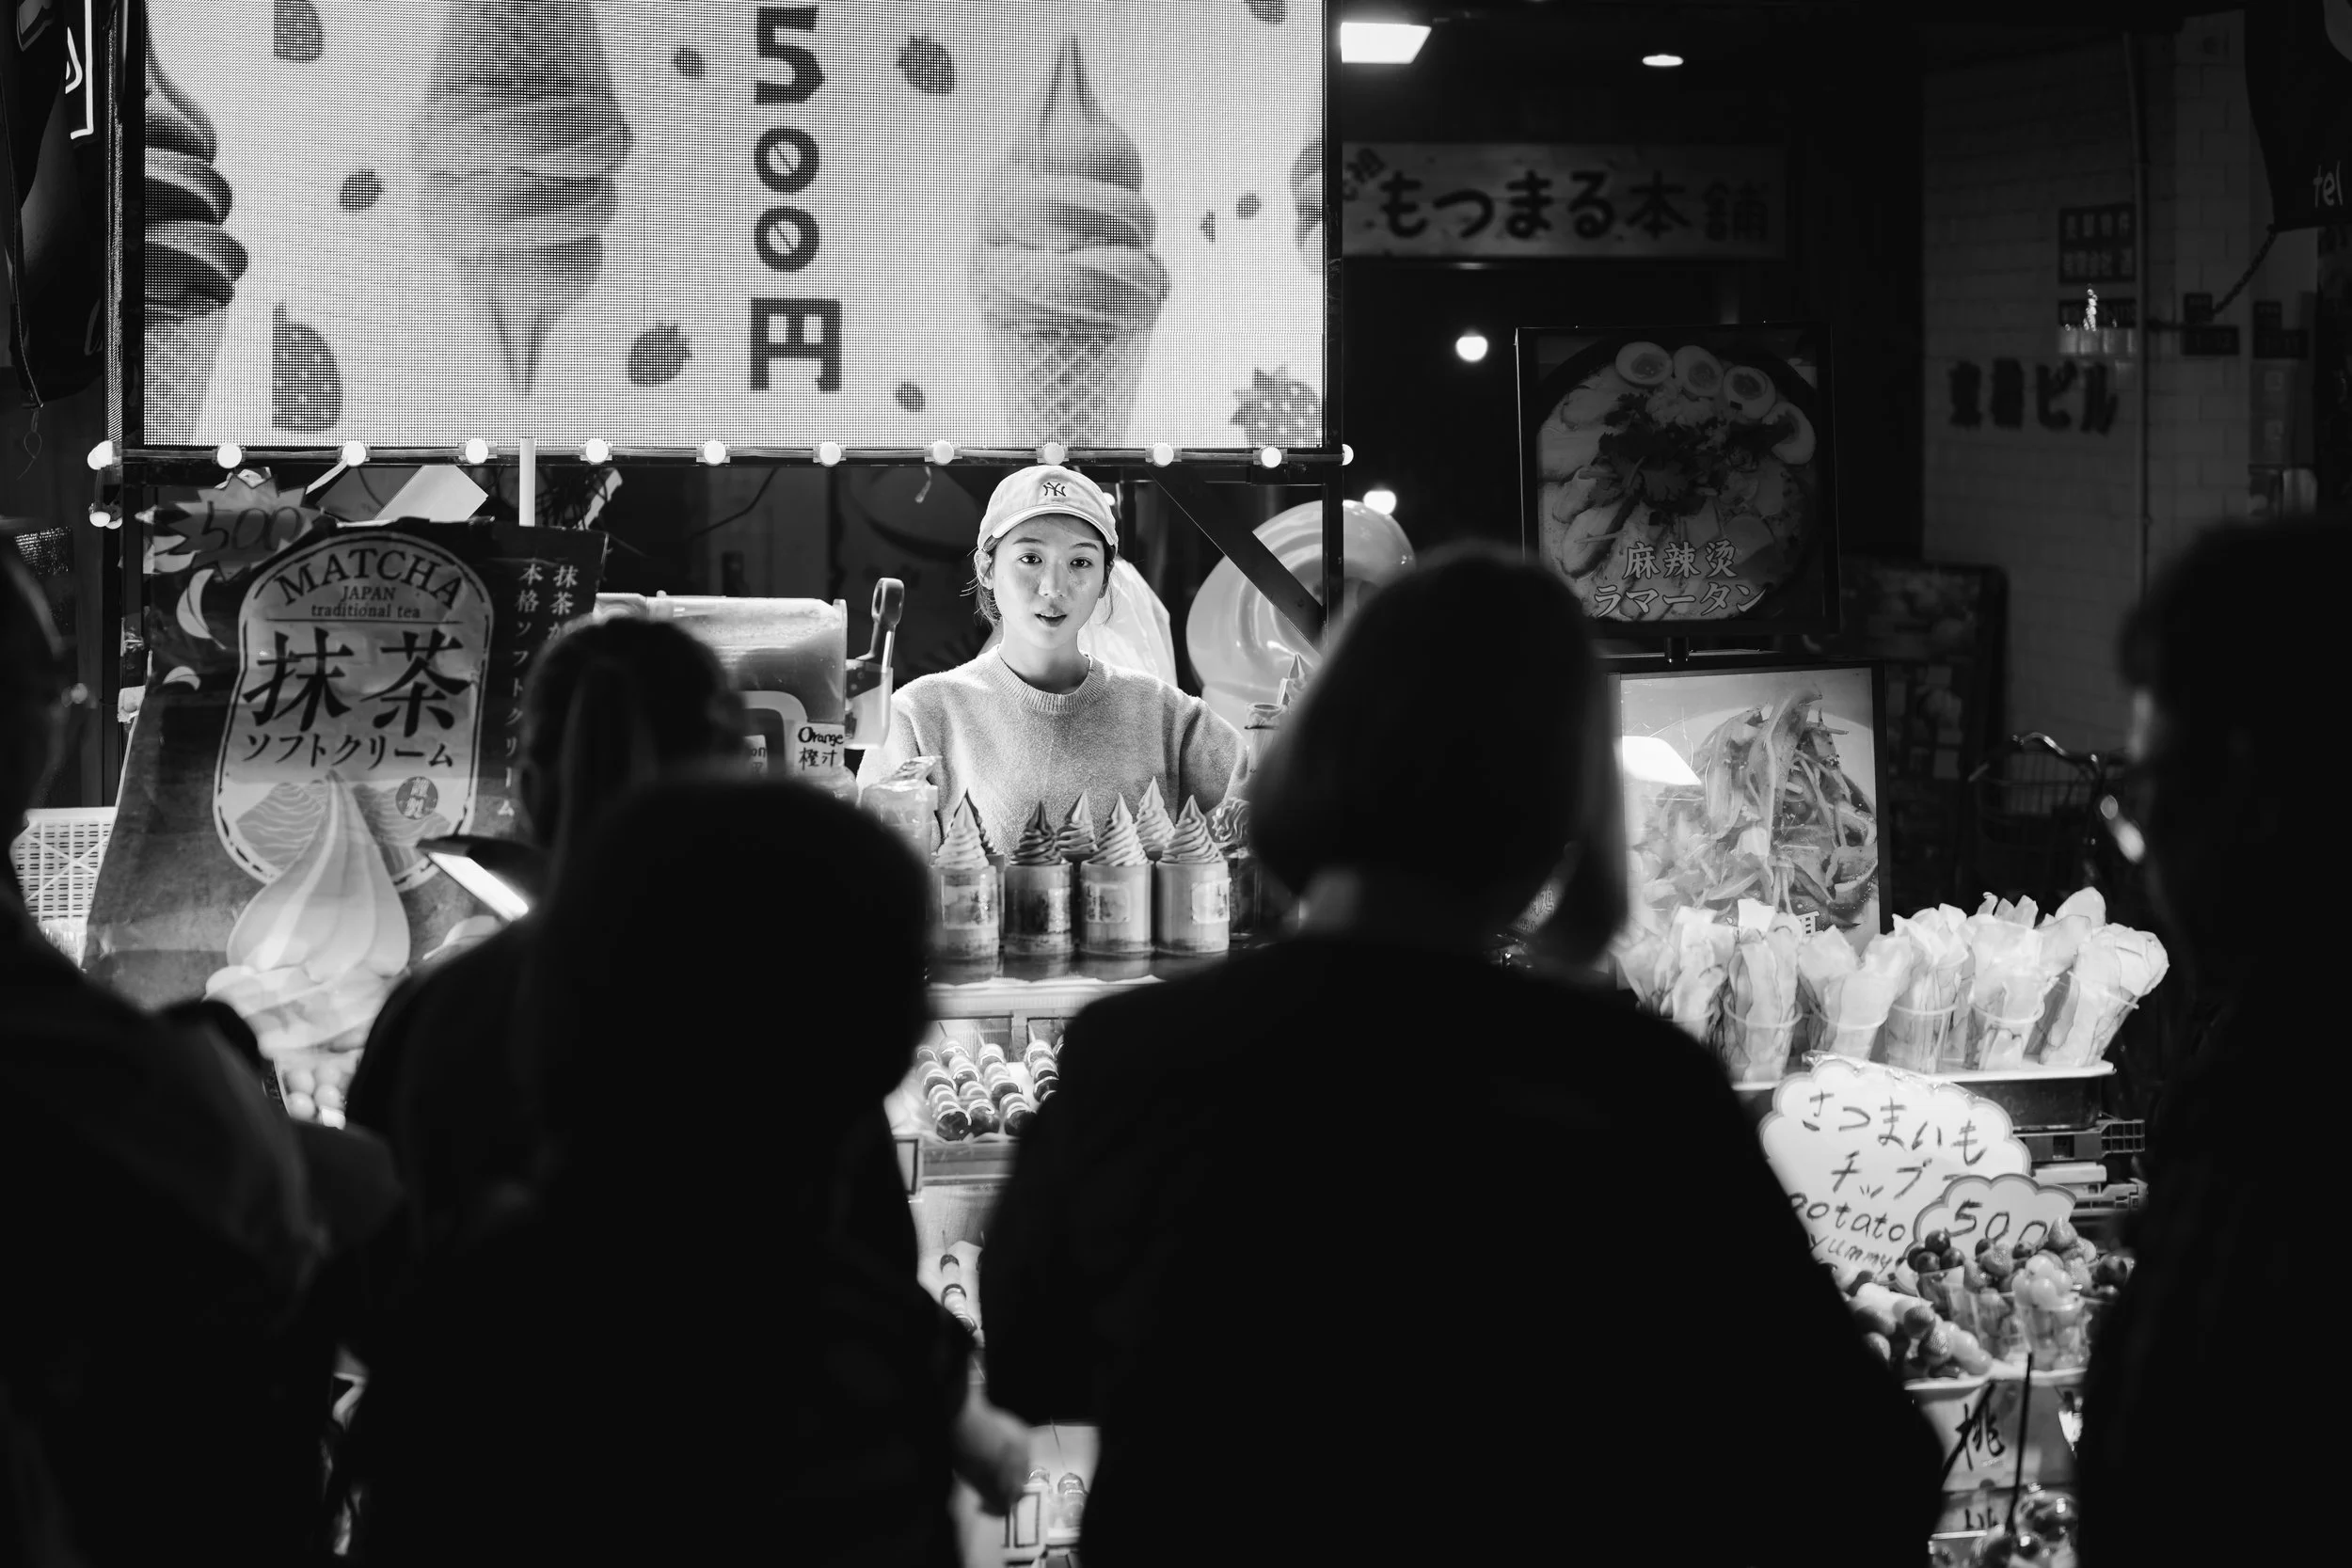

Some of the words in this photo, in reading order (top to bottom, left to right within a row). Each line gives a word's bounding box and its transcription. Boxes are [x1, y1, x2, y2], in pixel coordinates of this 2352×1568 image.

[1379, 168, 1770, 242] もつまる本舗
[1042, 482, 1067, 498] NY
[200, 500, 304, 551] 500
[274, 548, 462, 610] MATCHA
[1622, 539, 1738, 579] 麻辣烫
[311, 605, 391, 618] traditional
[397, 606, 421, 619] tea
[341, 586, 396, 602] JAPAN
[1594, 582, 1767, 618] ラマータン
[242, 626, 473, 738] 抹茶
[498, 563, 545, 817] 本格ソフトクリーム
[242, 733, 453, 771] ソフトクリーム
[798, 726, 844, 747] Orange
[798, 747, 838, 770] 橙汁
[1803, 1089, 1988, 1166] さつまいも
[1831, 1150, 1969, 1200] チップ
[1945, 1199, 2049, 1245] 500
